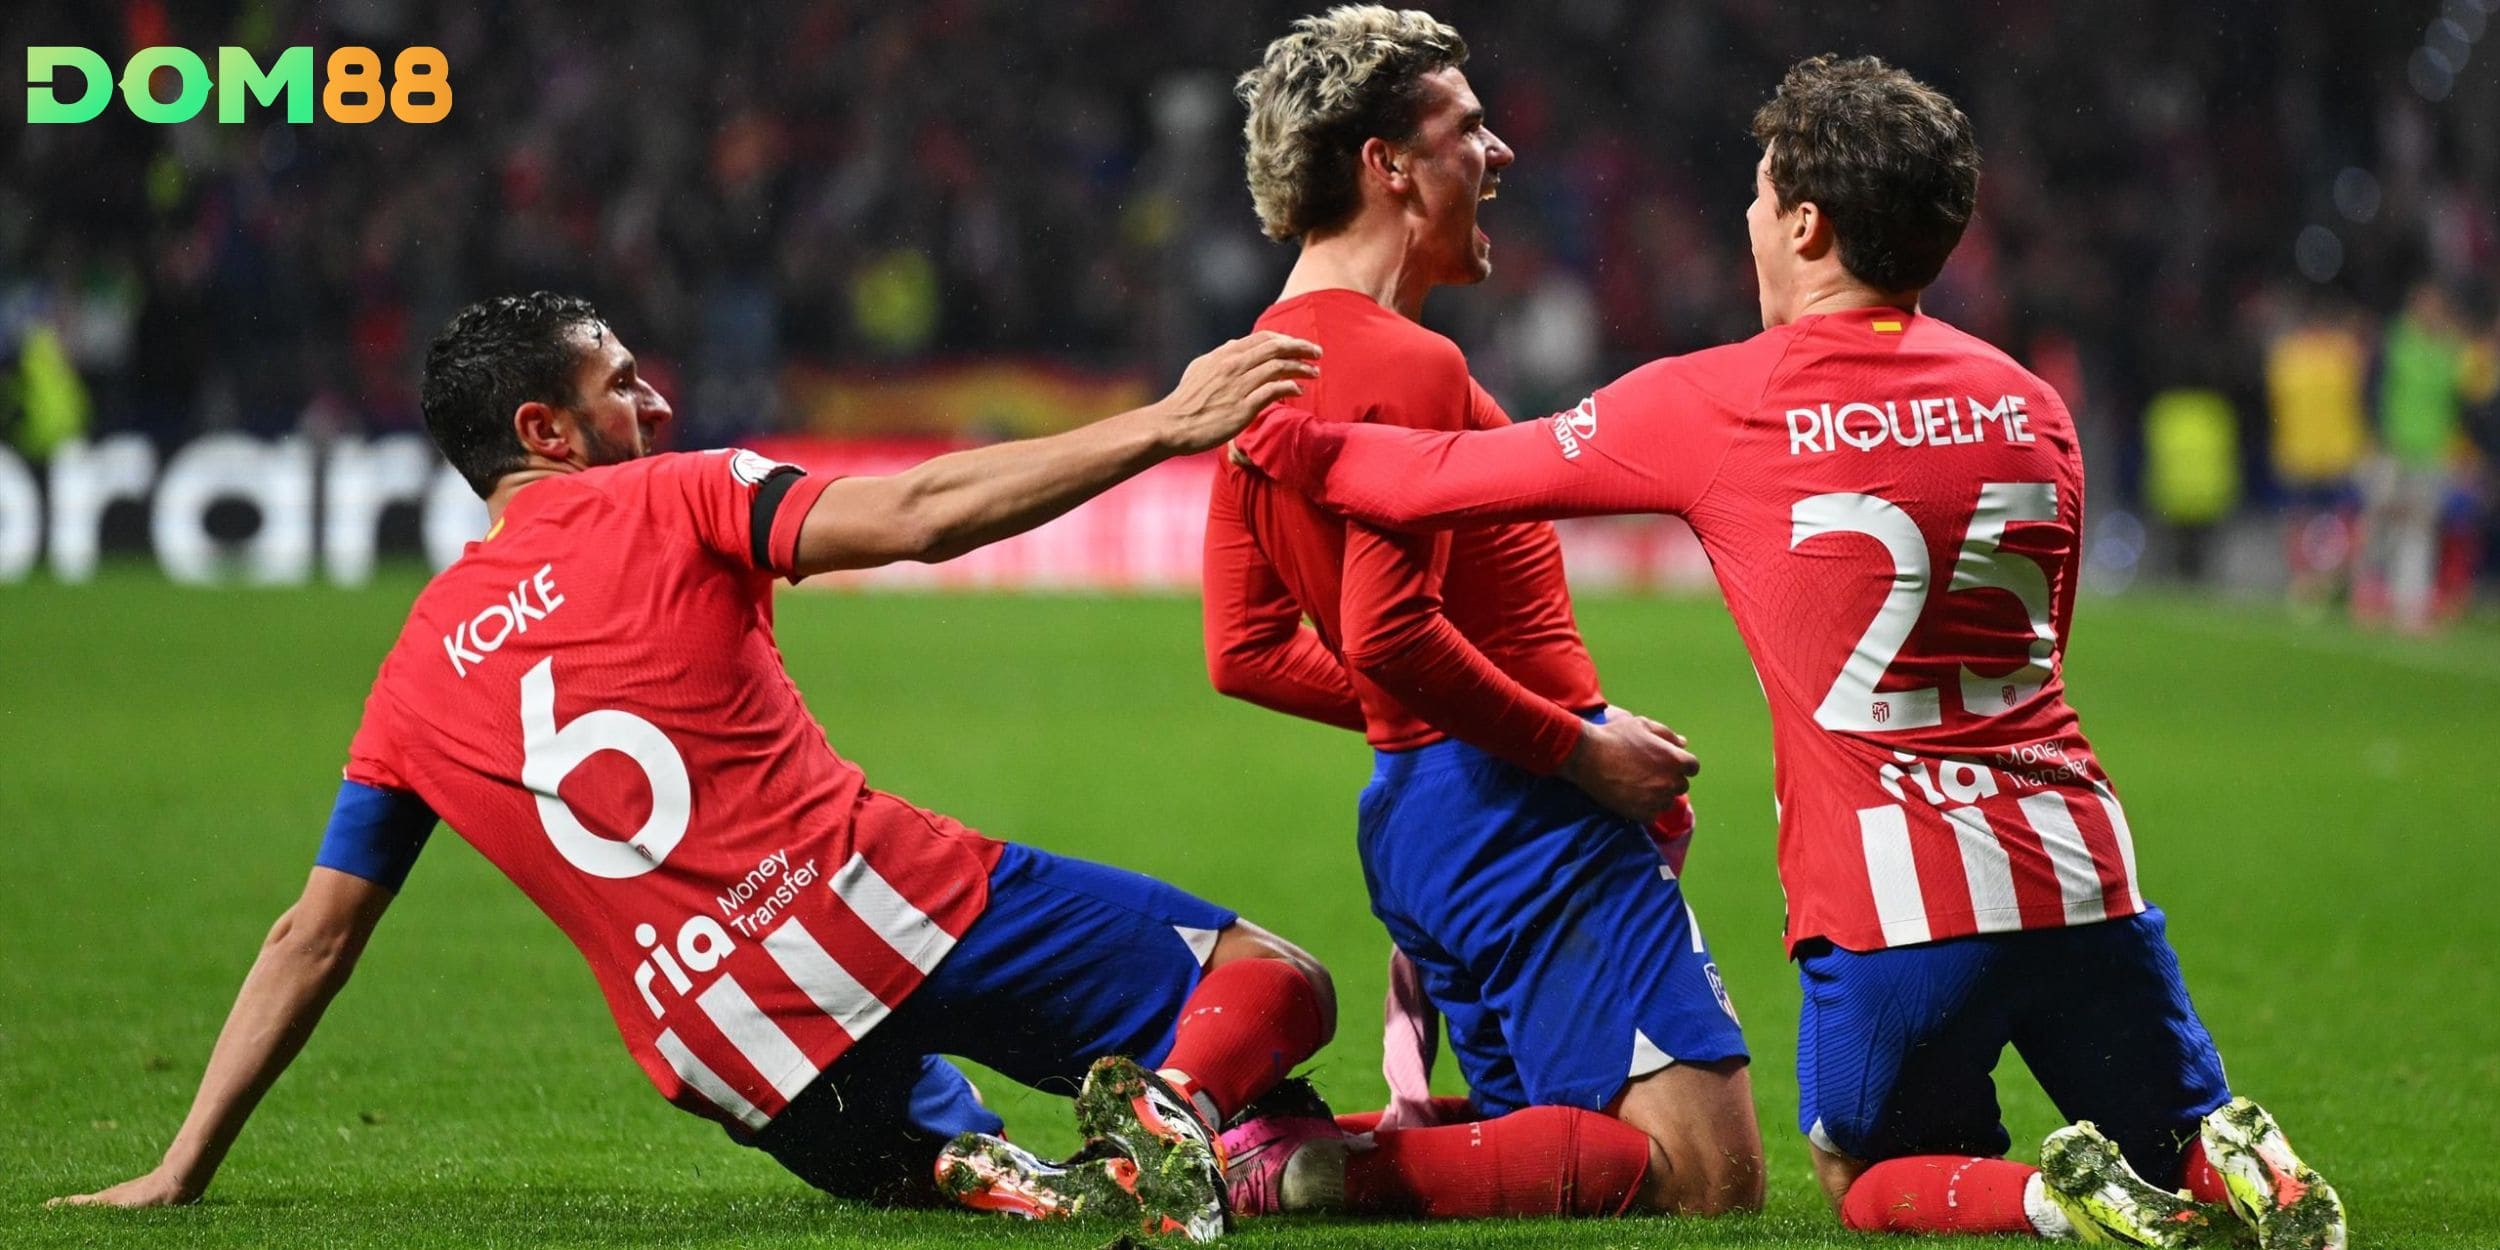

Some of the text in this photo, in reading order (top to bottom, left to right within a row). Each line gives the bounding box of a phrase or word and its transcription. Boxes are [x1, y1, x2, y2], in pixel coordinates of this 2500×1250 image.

[1786, 394, 2036, 456] RIQUELME
[444, 563, 565, 678] KOKE
[1790, 482, 2058, 733] 25
[520, 655, 691, 879] 6
[1879, 749, 2000, 805] ria
[1997, 739, 2066, 766] Money
[2003, 757, 2089, 789] Transfer
[716, 848, 791, 917] Money
[730, 858, 820, 938] Transfer
[634, 915, 737, 1020] ria
